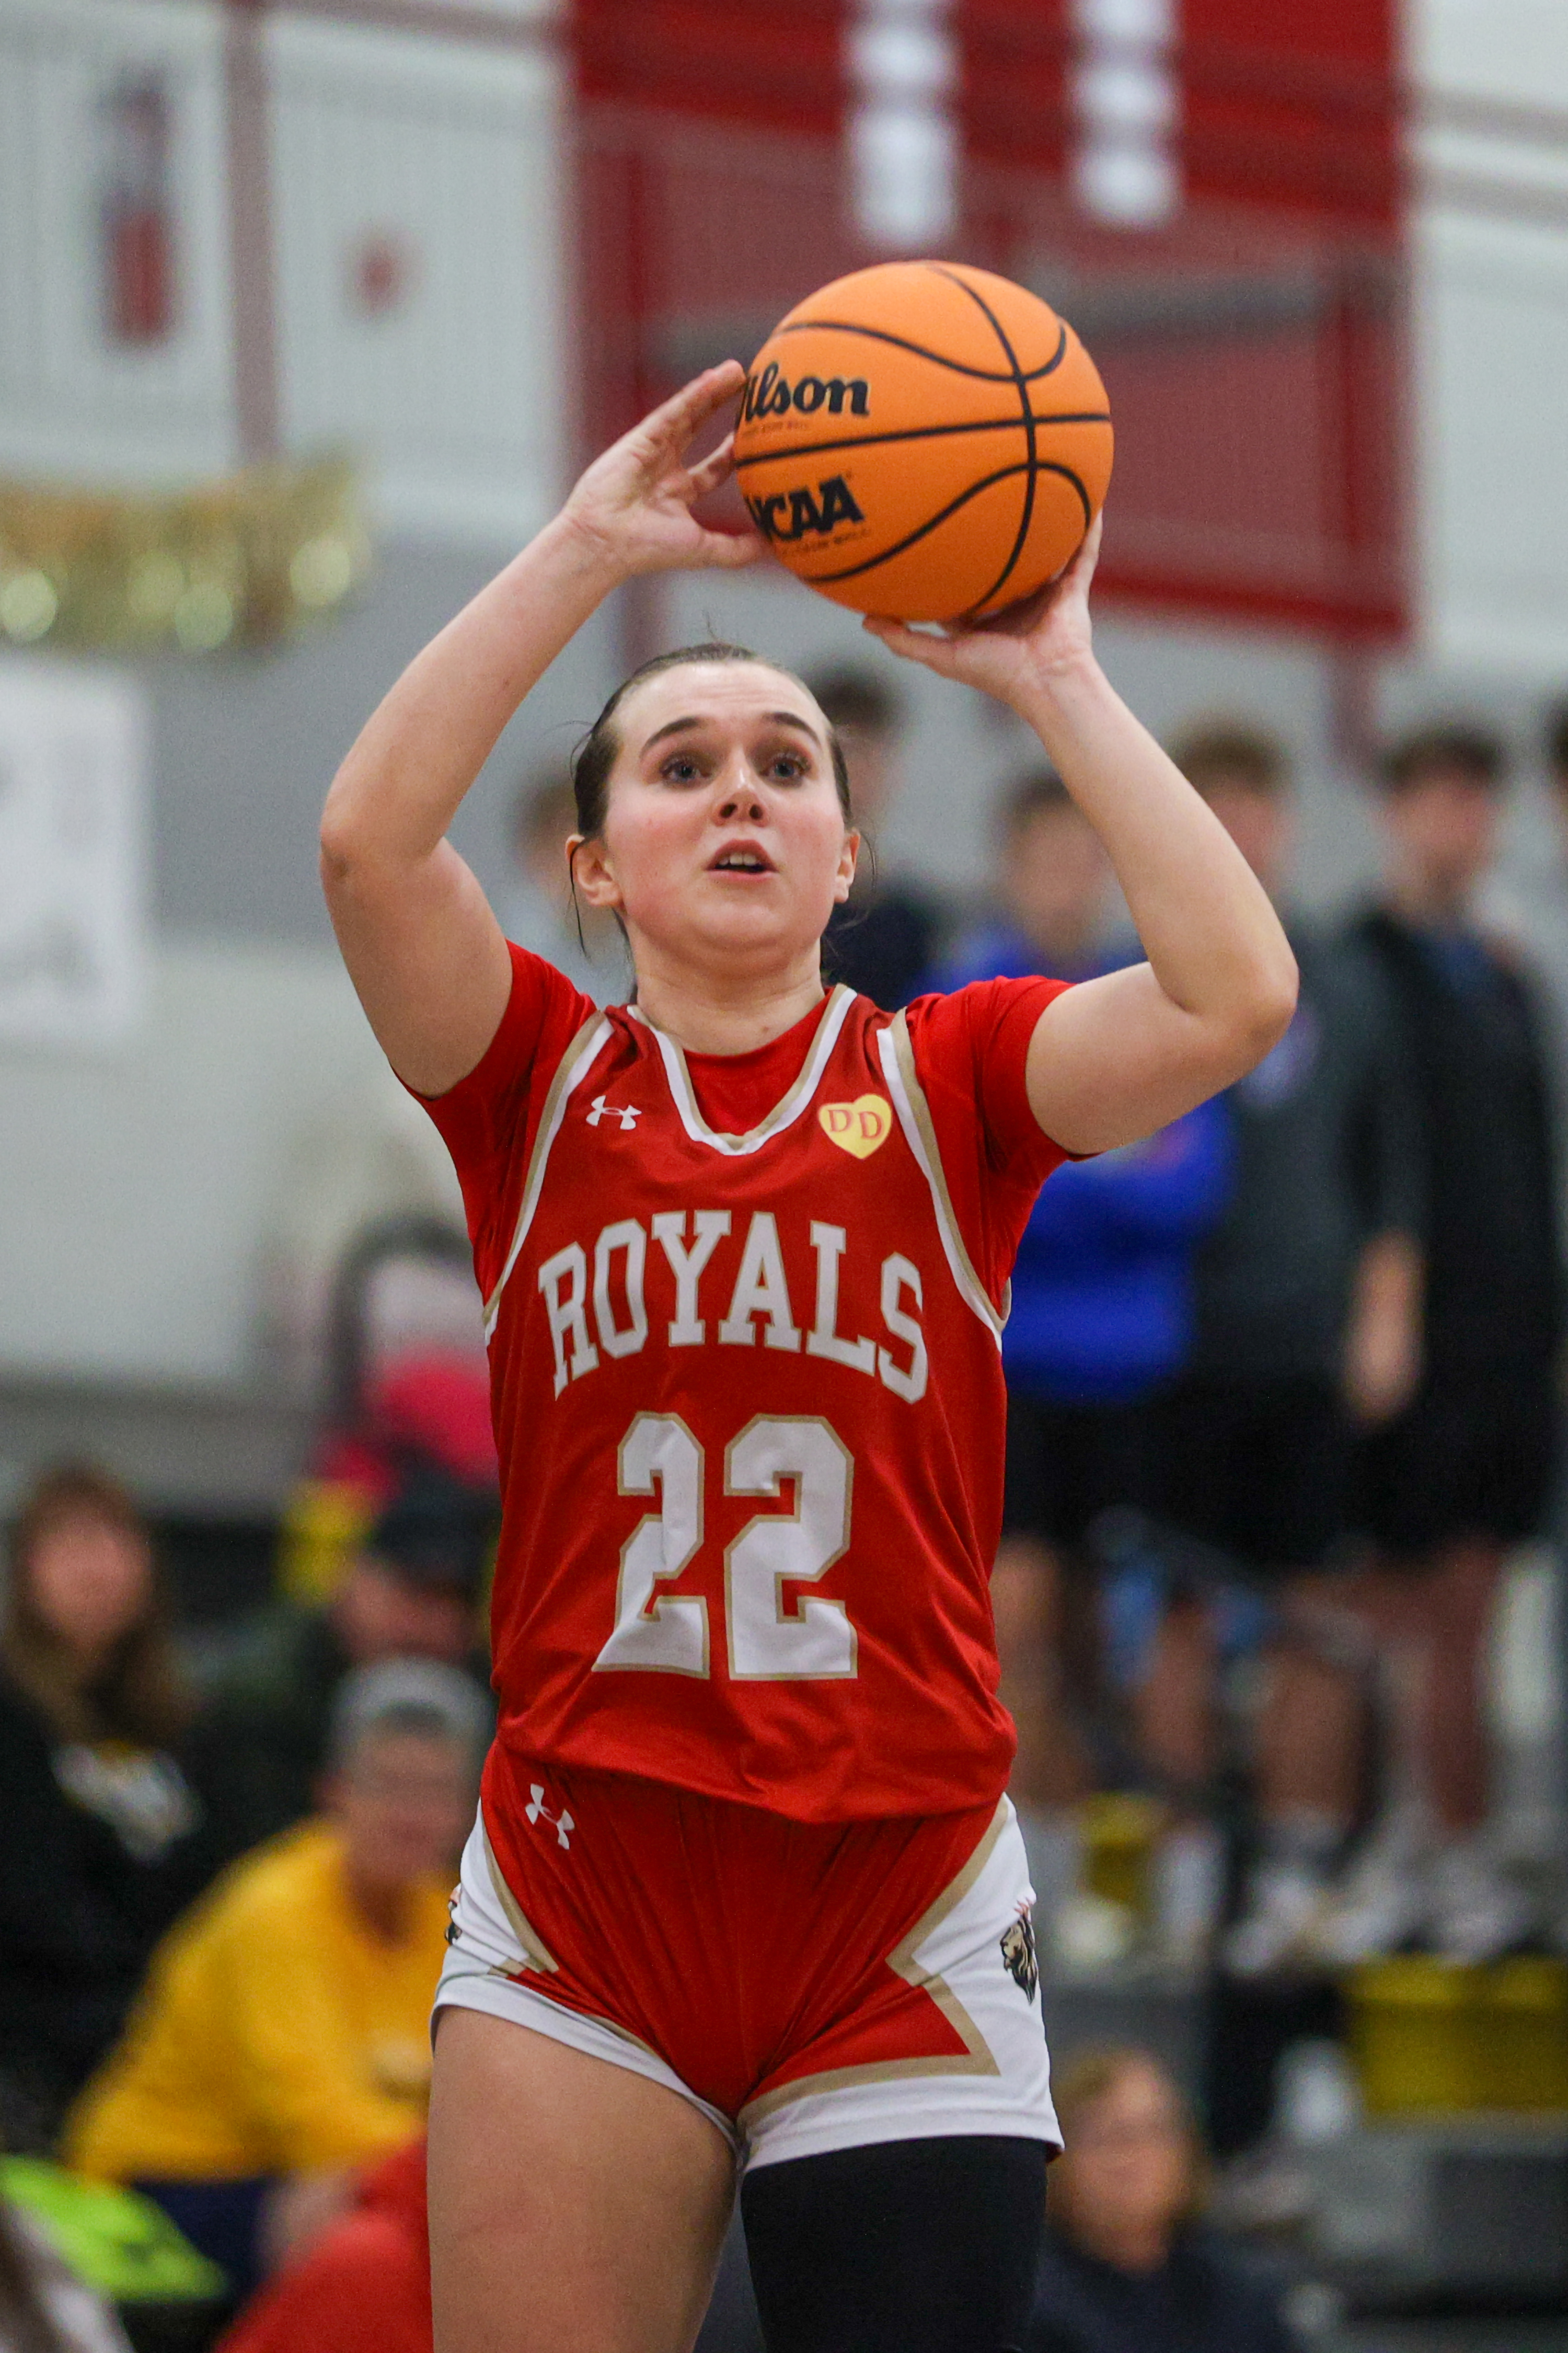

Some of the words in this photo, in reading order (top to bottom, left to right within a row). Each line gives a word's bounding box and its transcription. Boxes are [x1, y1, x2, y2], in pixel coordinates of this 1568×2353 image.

[742, 361, 869, 421] ilson
[538, 1210, 928, 1405] ROYALS
[591, 1411, 858, 1680] 22
